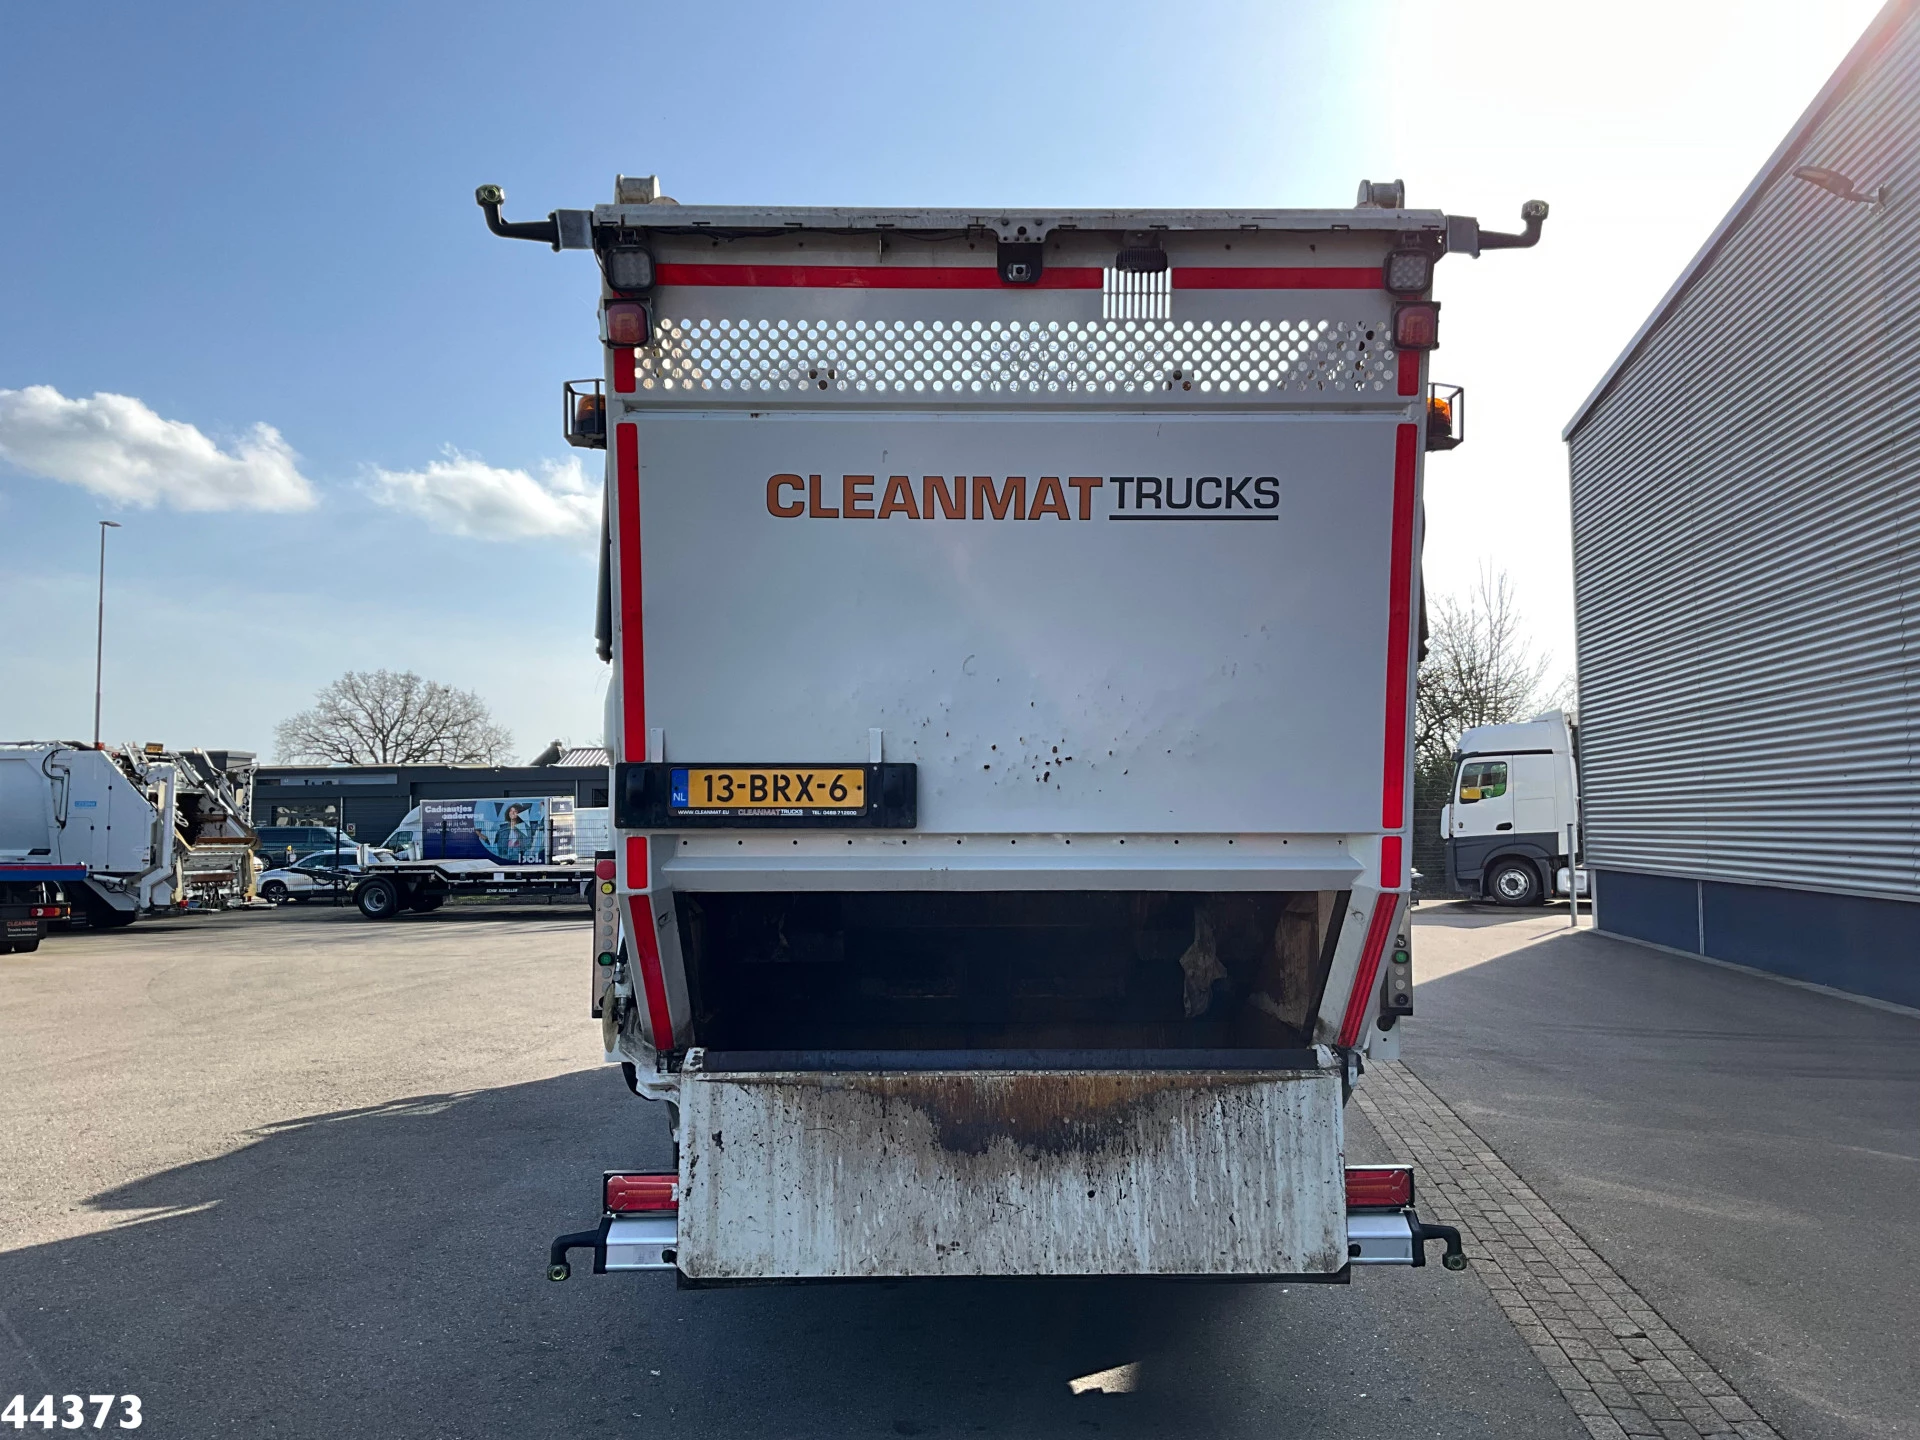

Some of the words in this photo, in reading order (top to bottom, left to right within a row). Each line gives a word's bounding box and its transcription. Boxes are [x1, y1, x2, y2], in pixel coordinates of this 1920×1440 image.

[766, 473, 1103, 521] CLEANMAT
[1109, 476, 1280, 510] TRUCKS
[673, 792, 687, 802] NL
[703, 773, 848, 803] 13-BRX-6
